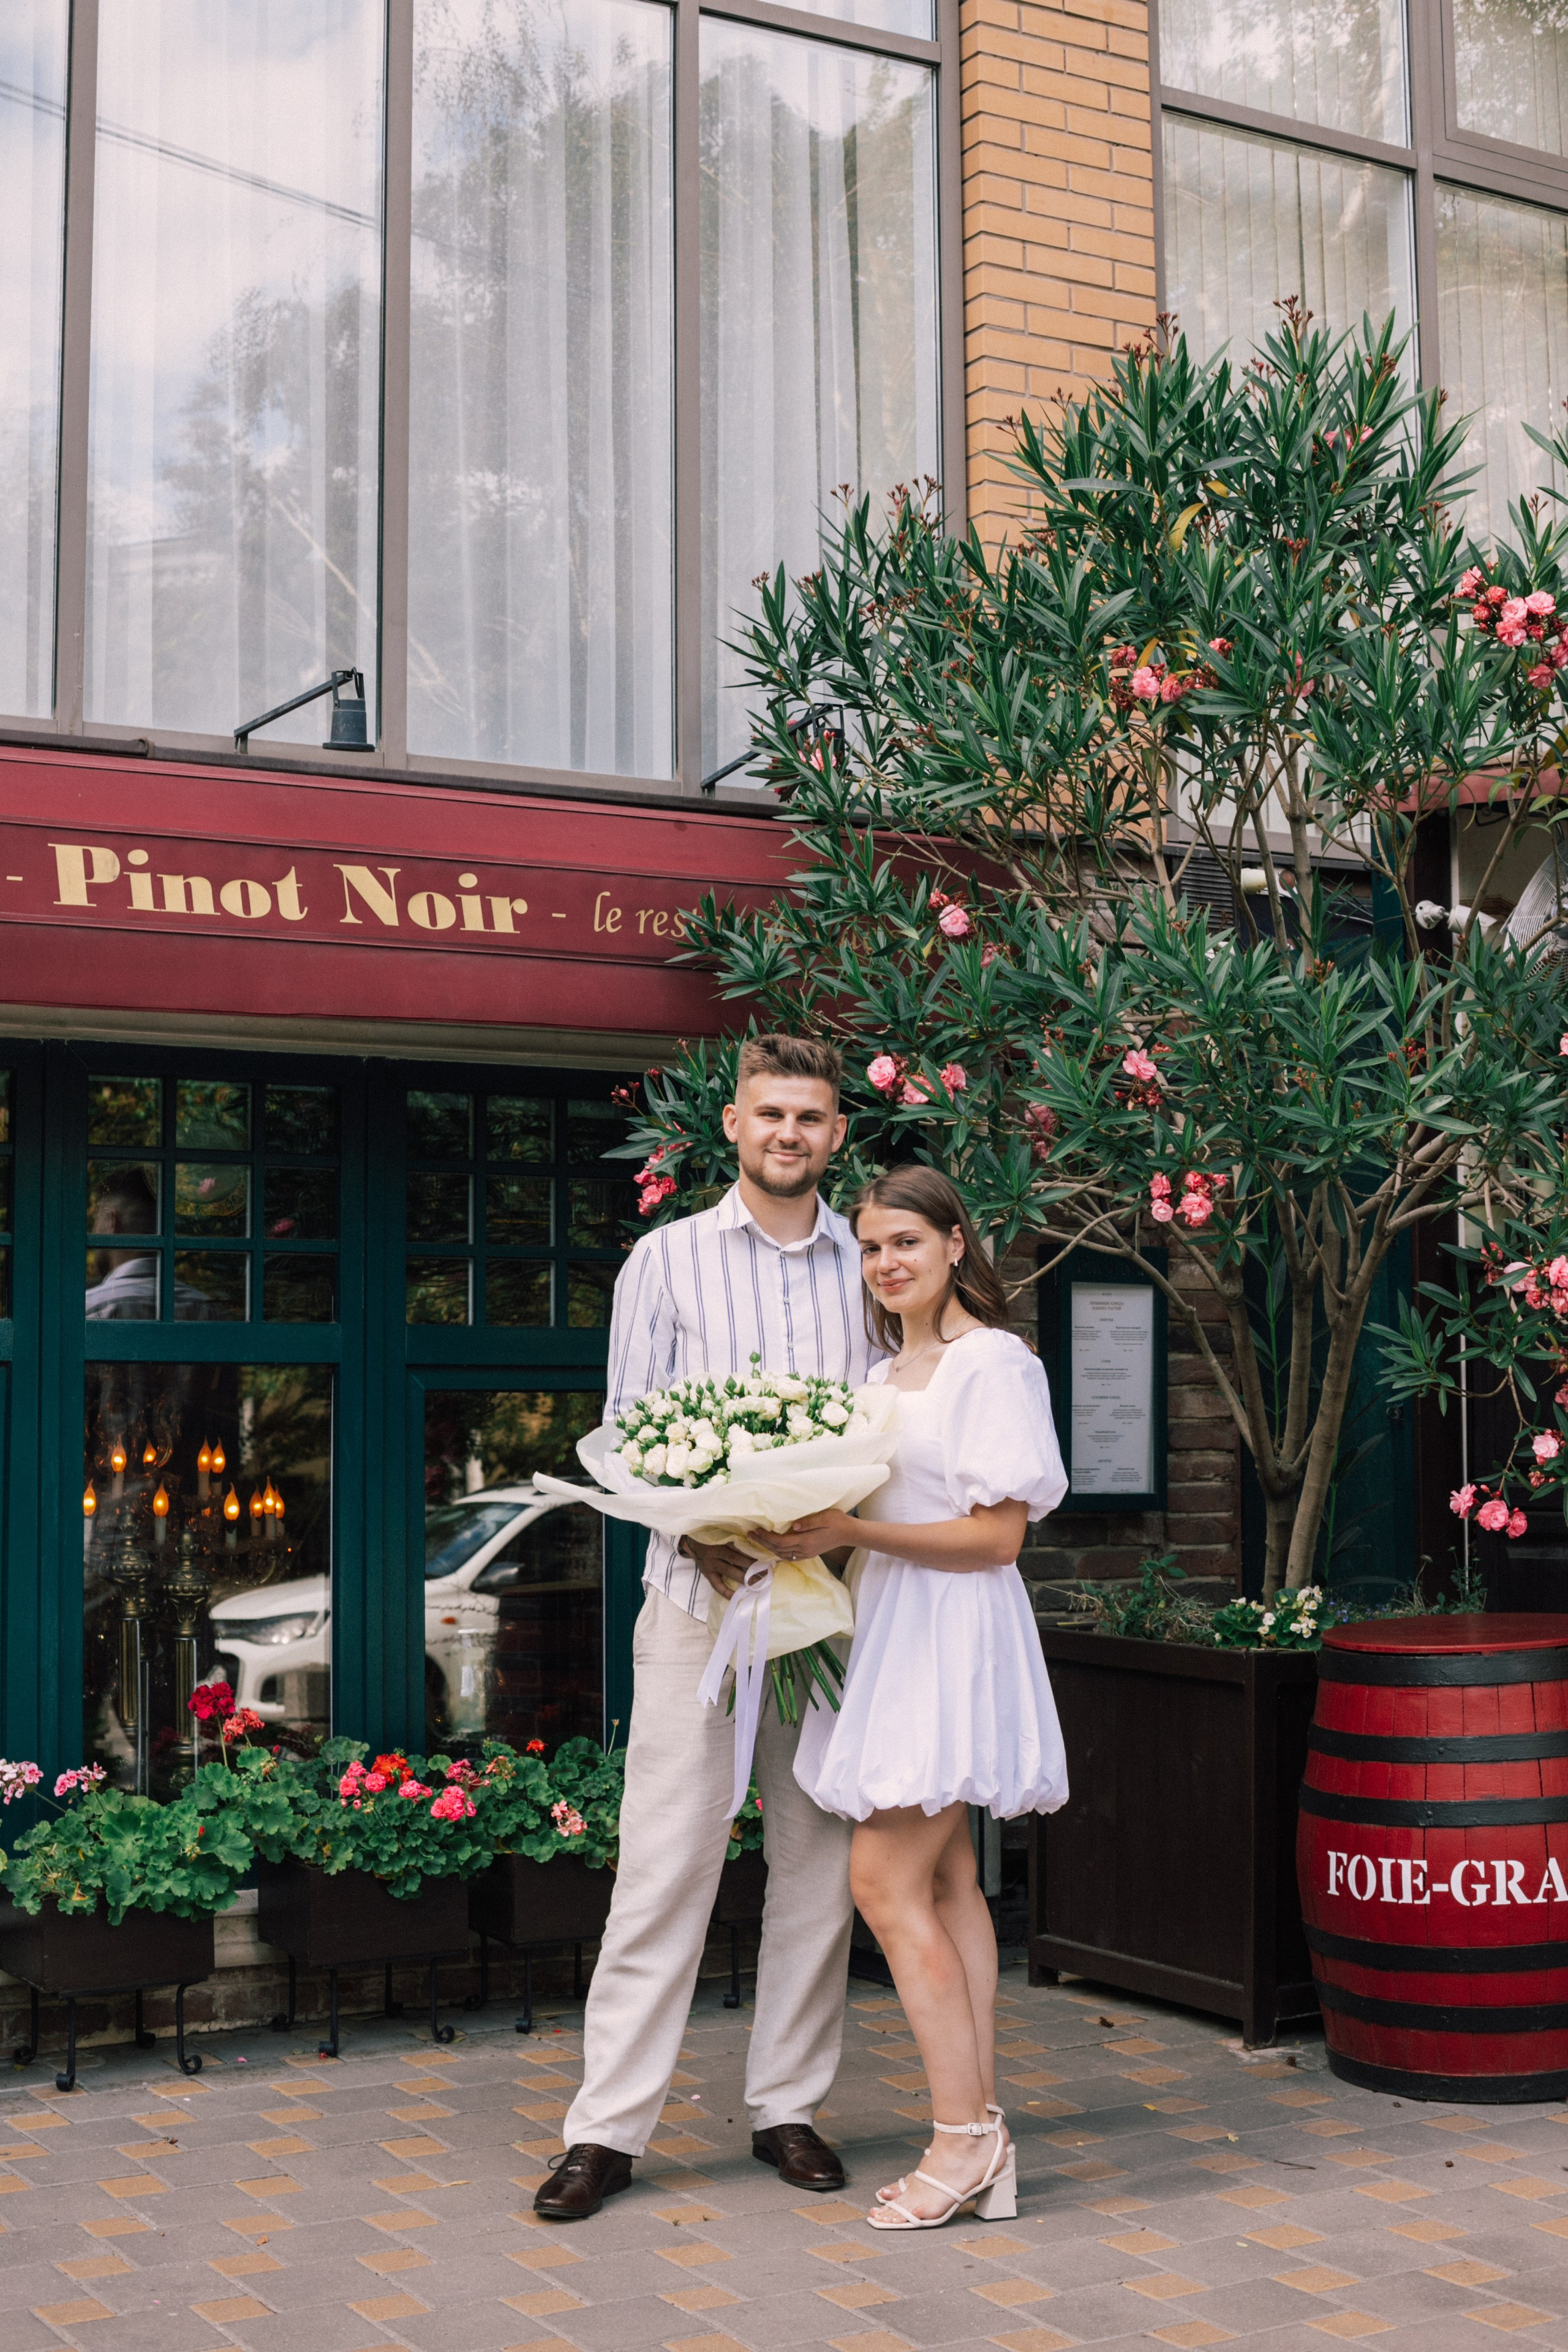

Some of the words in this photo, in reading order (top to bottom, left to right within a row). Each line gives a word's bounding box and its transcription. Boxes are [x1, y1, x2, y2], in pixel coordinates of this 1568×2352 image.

[47, 843, 308, 921] Pinot
[333, 864, 528, 934] Noir
[594, 891, 622, 933] le
[1327, 1850, 1568, 1907] FOIE-GRA
